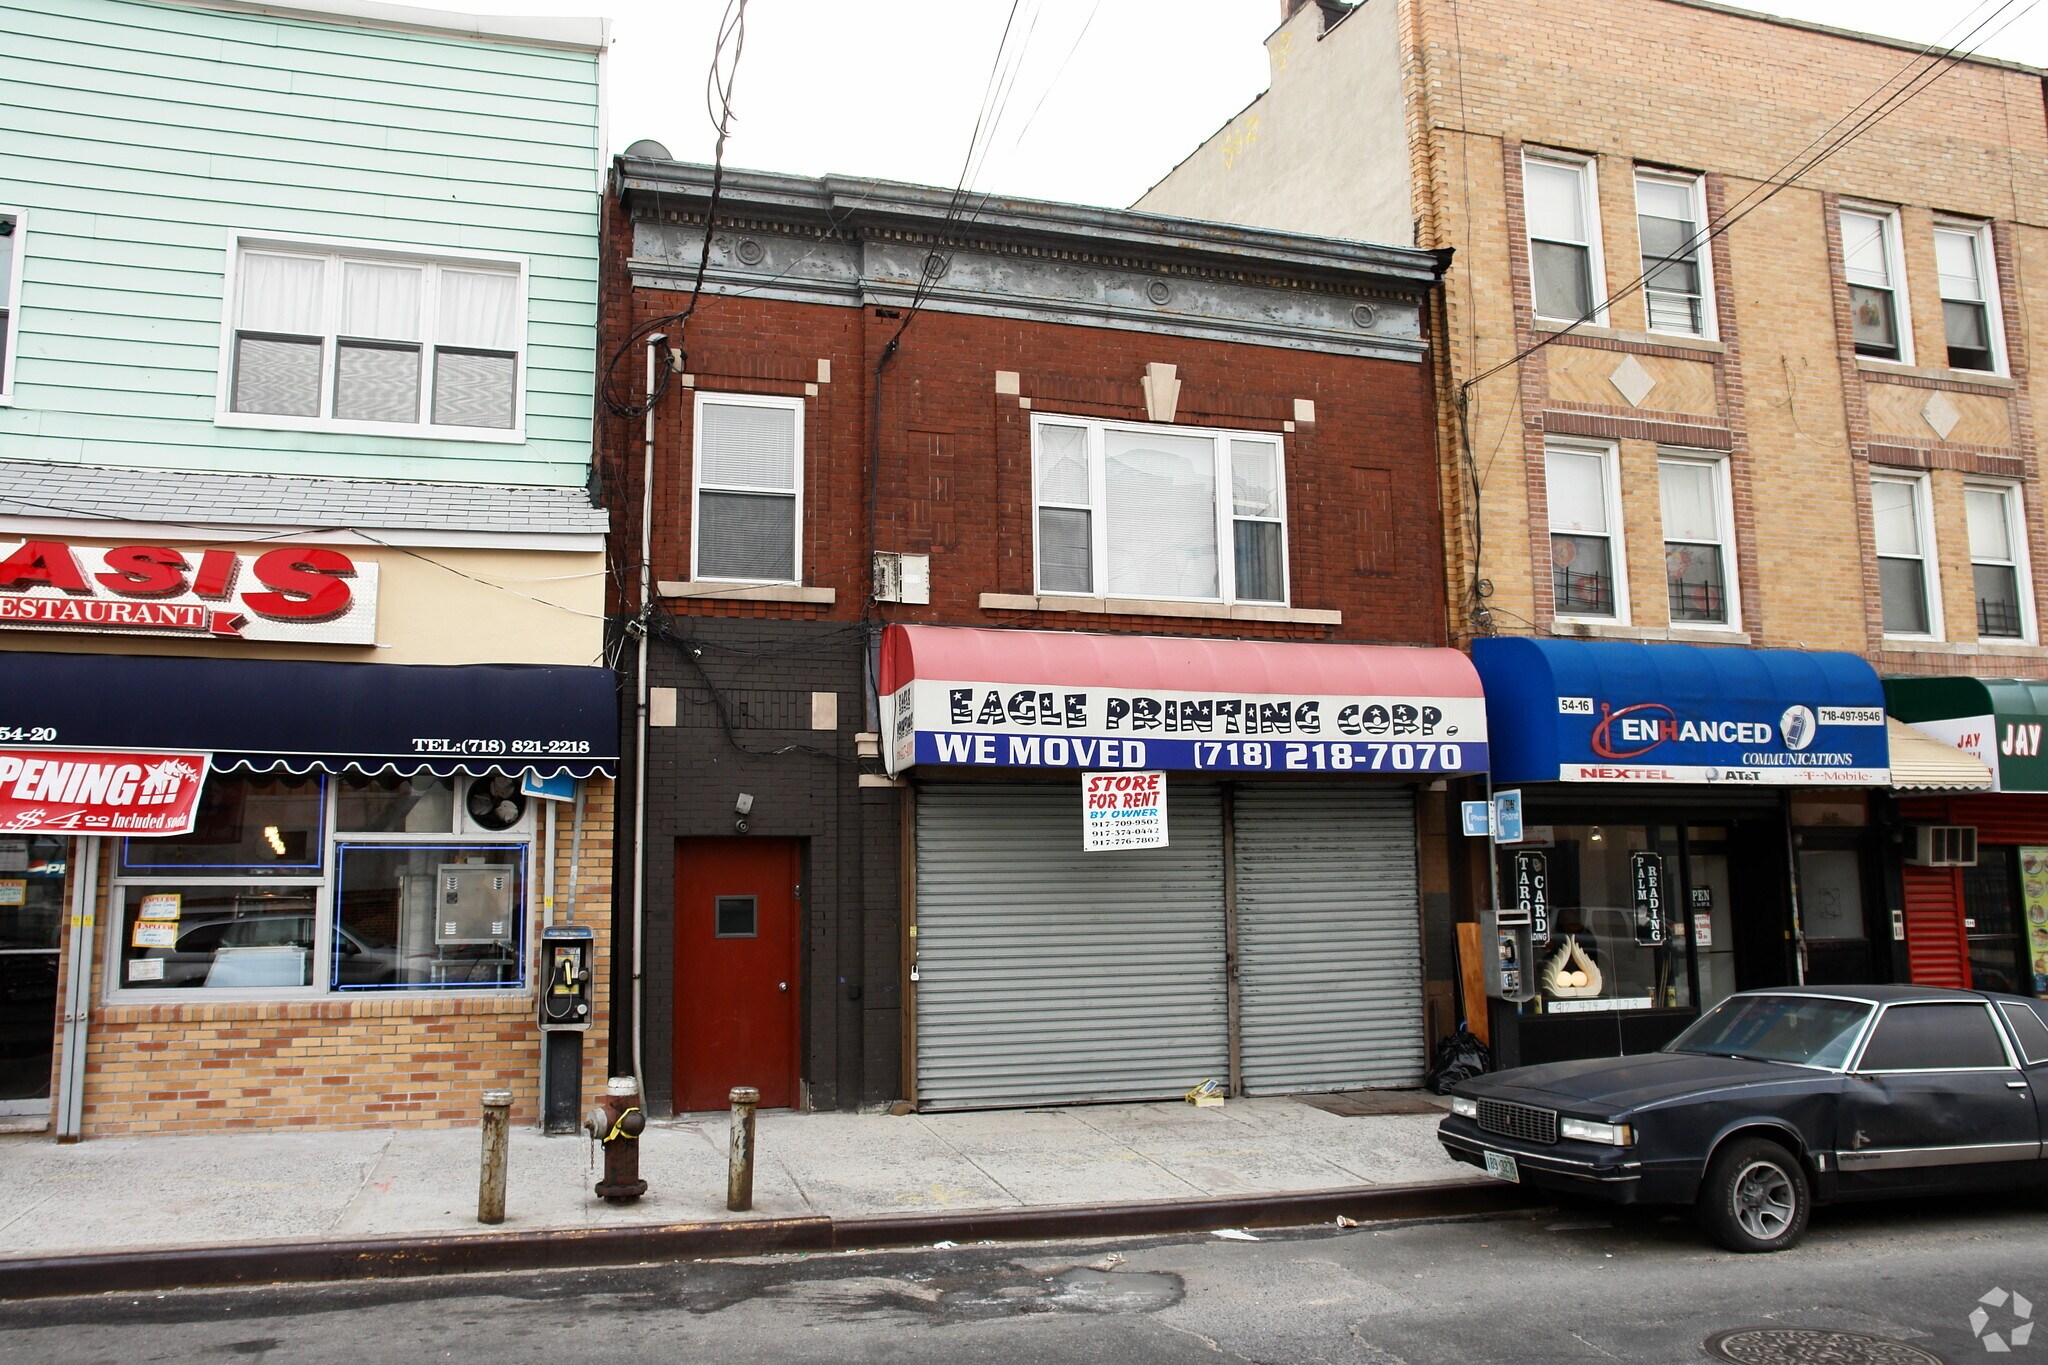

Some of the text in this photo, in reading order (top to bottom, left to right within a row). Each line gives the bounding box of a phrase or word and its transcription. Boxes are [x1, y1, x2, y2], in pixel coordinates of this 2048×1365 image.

[949, 688, 1459, 736] EAGLE PRINTING CORP.
[1561, 700, 1590, 711] 54-16
[1821, 710, 1881, 722] 718-497-9546
[0, 727, 57, 741] 54-20
[1622, 719, 1772, 744] ENHANCED
[511, 740, 590, 754] 821-2218
[1957, 733, 1981, 748] JAY
[2001, 724, 2041, 756] JAY
[934, 733, 997, 763] WE
[1008, 736, 1146, 768] MOVED
[1194, 742, 1271, 769] (718)
[1285, 744, 1462, 770] 218-7070
[1742, 752, 1853, 766] COMMUNICATIONS
[1580, 768, 1674, 780] NEXTEL
[1725, 771, 1761, 781] AT&T
[1088, 774, 1160, 792] STORE
[1089, 791, 1160, 809] FOR RENT
[111, 812, 163, 829] Included
[166, 813, 188, 829] soda
[1090, 809, 1158, 819] BY OWNER
[1501, 812, 1519, 821] Phone
[1092, 819, 1159, 828] 917-709-9502
[1092, 828, 1159, 837] 917-374-0442
[1519, 857, 1531, 911] TARO
[1637, 857, 1647, 900] PALM
[1534, 875, 1547, 932] CARD
[1648, 866, 1661, 941] READING
